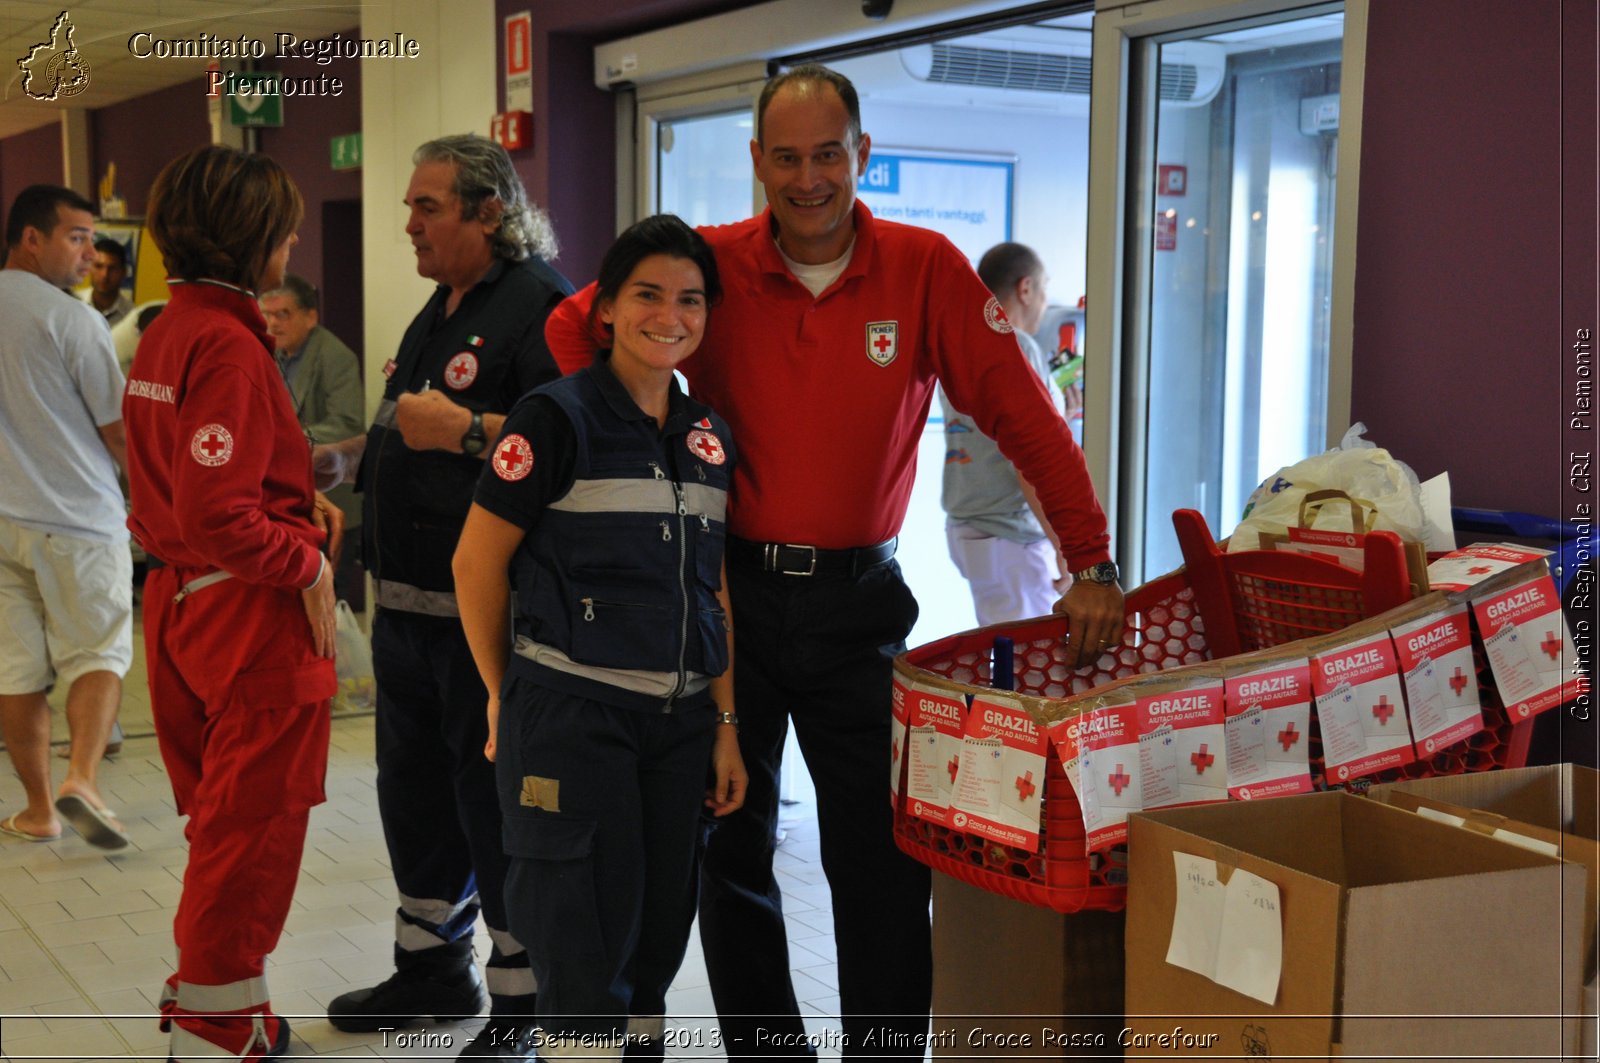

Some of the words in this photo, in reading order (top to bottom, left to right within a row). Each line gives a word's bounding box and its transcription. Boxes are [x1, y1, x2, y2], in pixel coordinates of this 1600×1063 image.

[858, 160, 890, 187] di
[881, 205, 902, 217] con
[905, 203, 934, 218] tanti
[1486, 587, 1545, 618] GRAZIE.
[1520, 600, 1546, 613] AIUTARE
[1408, 622, 1458, 652] GRAZIE.
[1324, 649, 1384, 676] GRAZIE.
[1359, 663, 1385, 674] AIUTARE
[1238, 675, 1299, 697] GRAZIE.
[1272, 689, 1299, 699] AIUTARE
[919, 698, 961, 722] GRAZIE.
[1148, 695, 1212, 715] GRAZIE.
[983, 710, 1039, 736] GRAZIE.
[1066, 714, 1125, 739] GRAZIE.
[1148, 715, 1174, 724] AIUTACI
[1184, 709, 1211, 719] AIUTARE
[1004, 730, 1014, 738] AD
[1014, 732, 1039, 745] AIUTARE
[968, 819, 987, 830] Croce
[987, 825, 1007, 836] Rossa
[1007, 831, 1027, 842] Italiana
